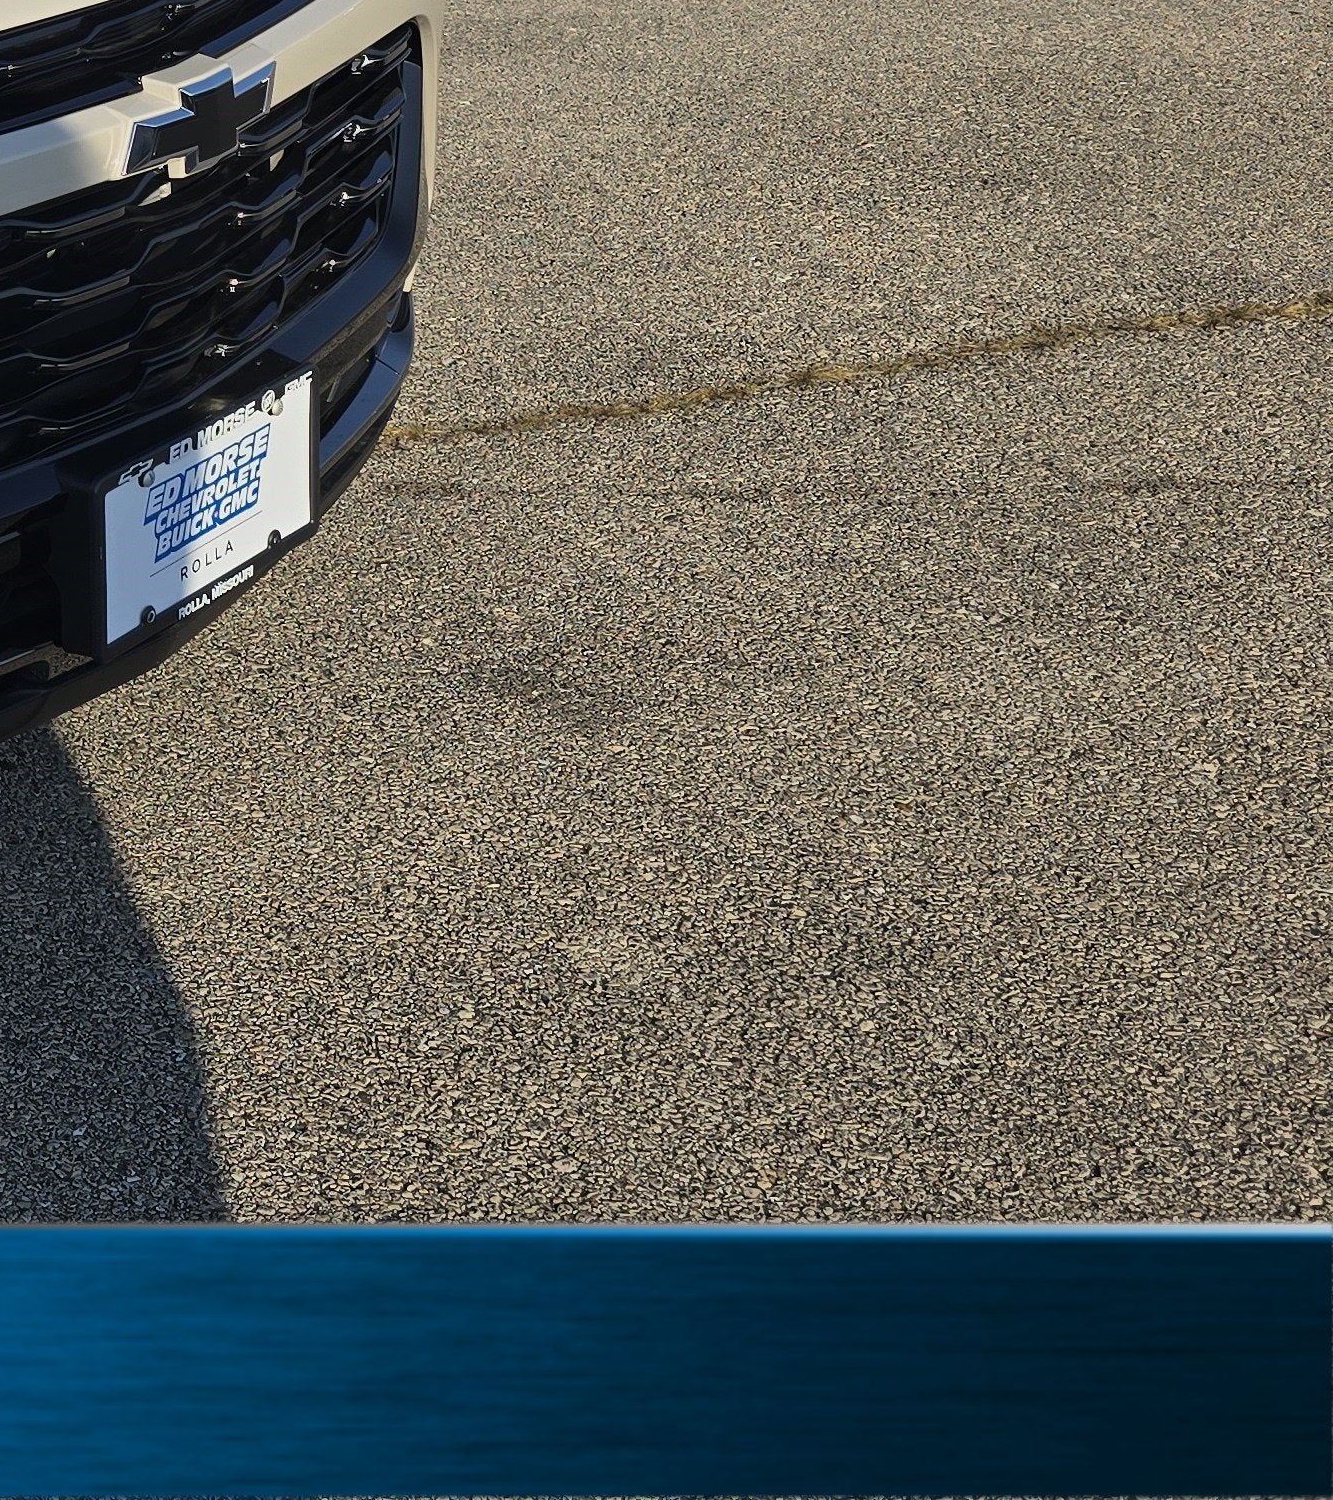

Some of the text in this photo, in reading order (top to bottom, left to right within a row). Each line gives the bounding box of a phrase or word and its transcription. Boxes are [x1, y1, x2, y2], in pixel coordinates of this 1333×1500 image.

[169, 436, 193, 465] ED
[197, 400, 257, 450] MORSE
[145, 425, 271, 519] ED MORSE
[155, 458, 262, 535] CHEVROLET
[180, 540, 234, 583] ROLLA
[211, 564, 254, 601] MISSOURI
